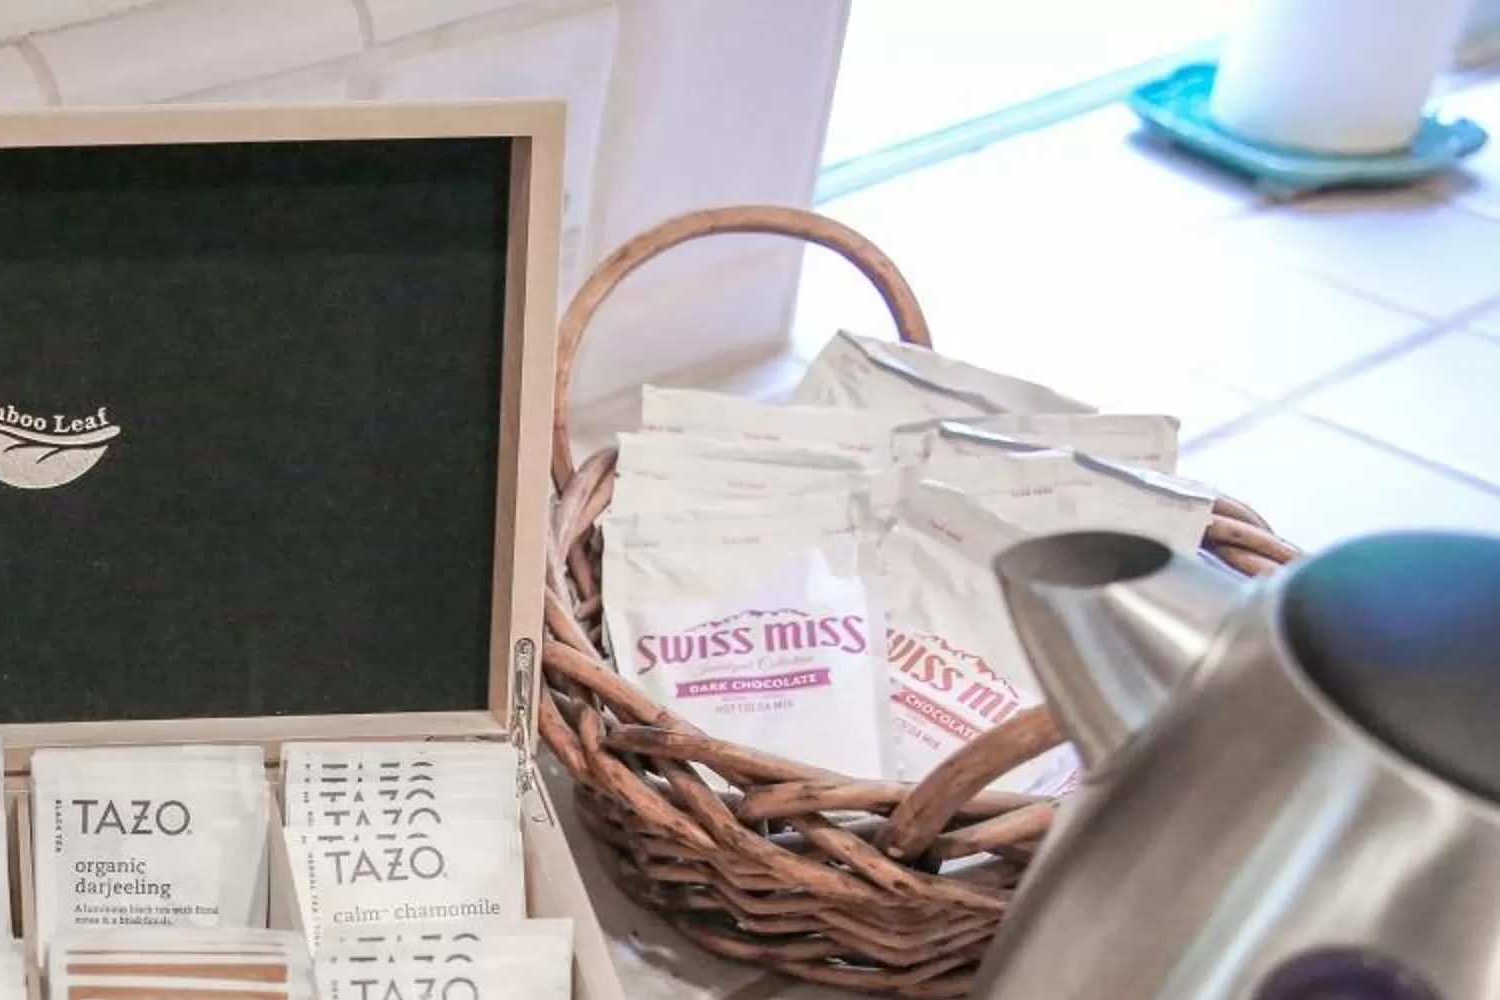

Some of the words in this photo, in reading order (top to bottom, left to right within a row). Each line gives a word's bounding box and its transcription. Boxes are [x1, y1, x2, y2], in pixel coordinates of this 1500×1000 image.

[53, 407, 109, 433] Leaf
[636, 626, 754, 675] SWISS
[764, 615, 867, 653] MISS
[886, 629, 964, 691] WISS
[689, 681, 728, 694] DARK
[731, 673, 818, 690] CHOCOLATE
[72, 799, 191, 836] TAZO
[75, 857, 147, 877] organic
[323, 845, 444, 884] TAZO
[75, 877, 171, 899] darjeeling
[333, 904, 379, 923] calm
[394, 899, 500, 919] chamomile
